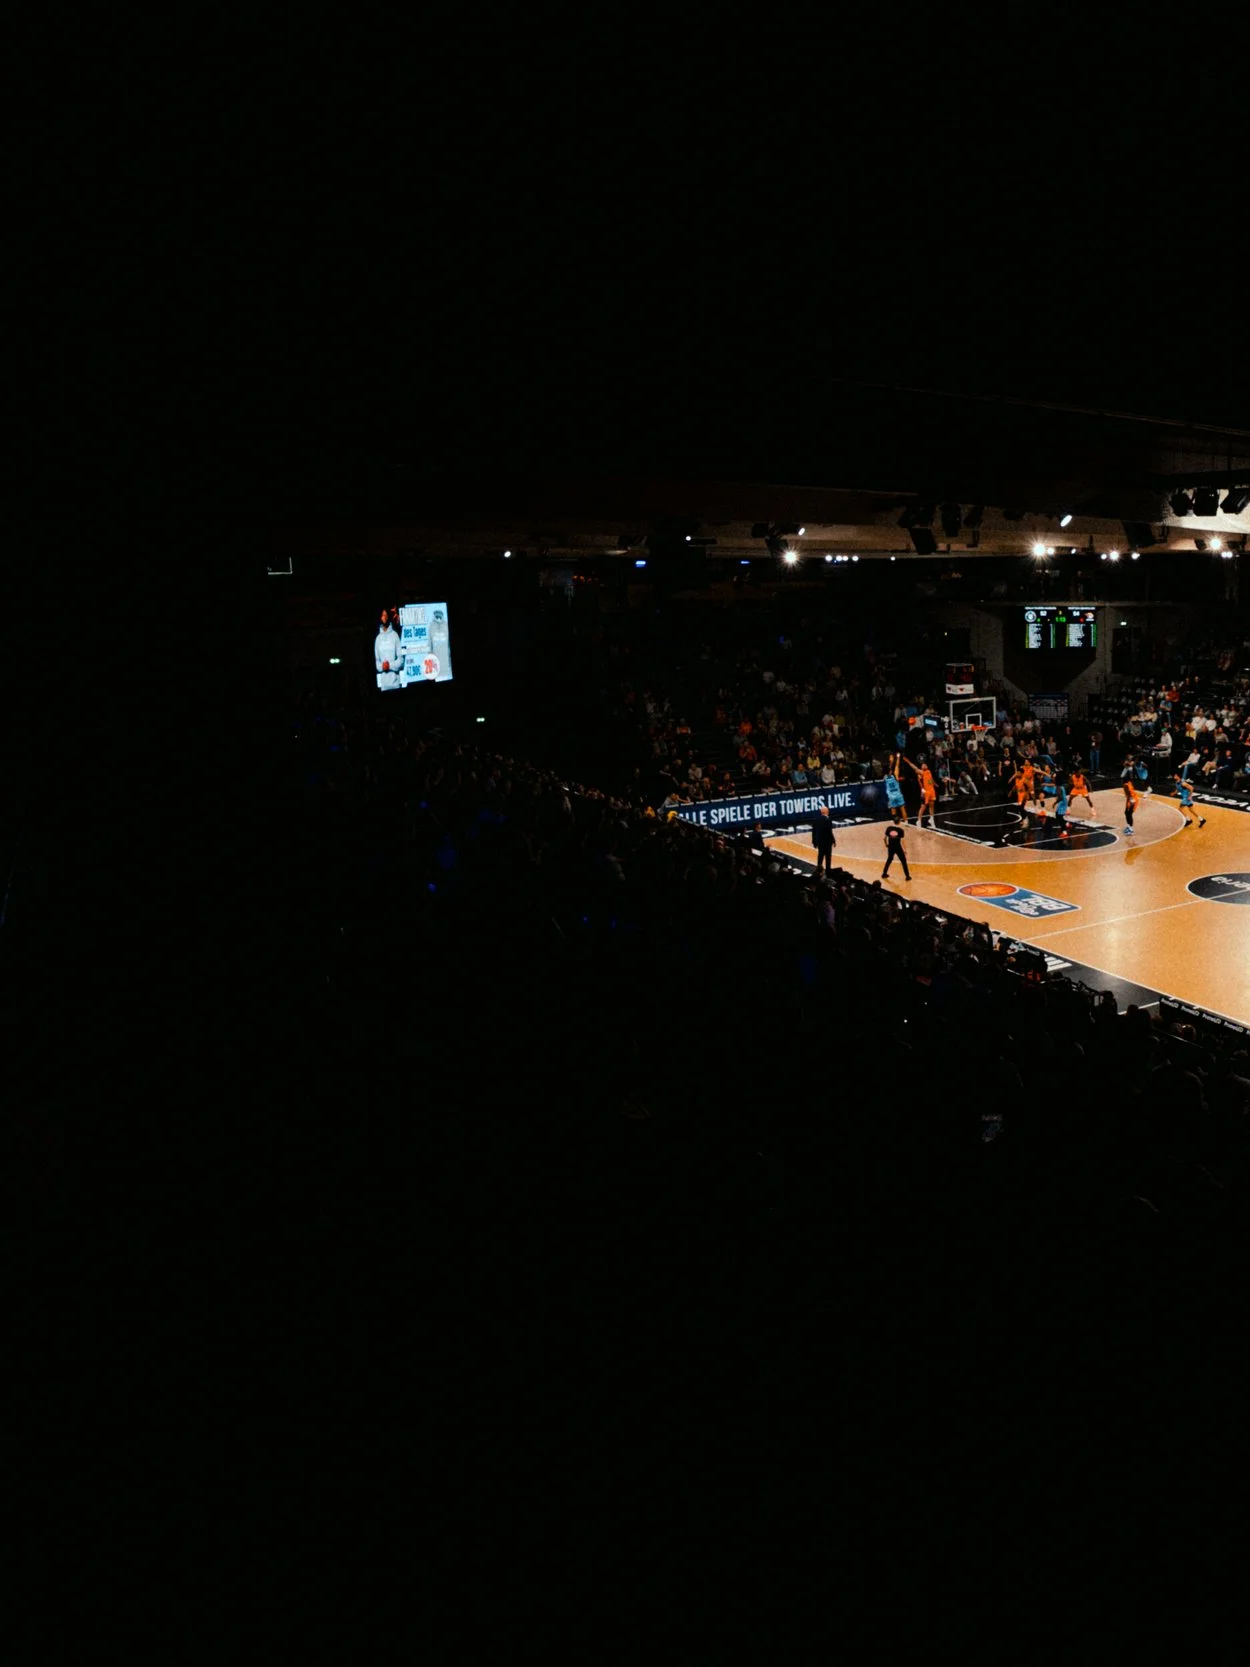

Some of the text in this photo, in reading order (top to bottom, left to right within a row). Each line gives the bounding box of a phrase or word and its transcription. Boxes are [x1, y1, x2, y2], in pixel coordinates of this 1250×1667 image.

[710, 804, 751, 825] SPIELE
[753, 801, 777, 819] DER
[779, 795, 826, 815] TOWERS
[827, 792, 856, 810] LIVE.
